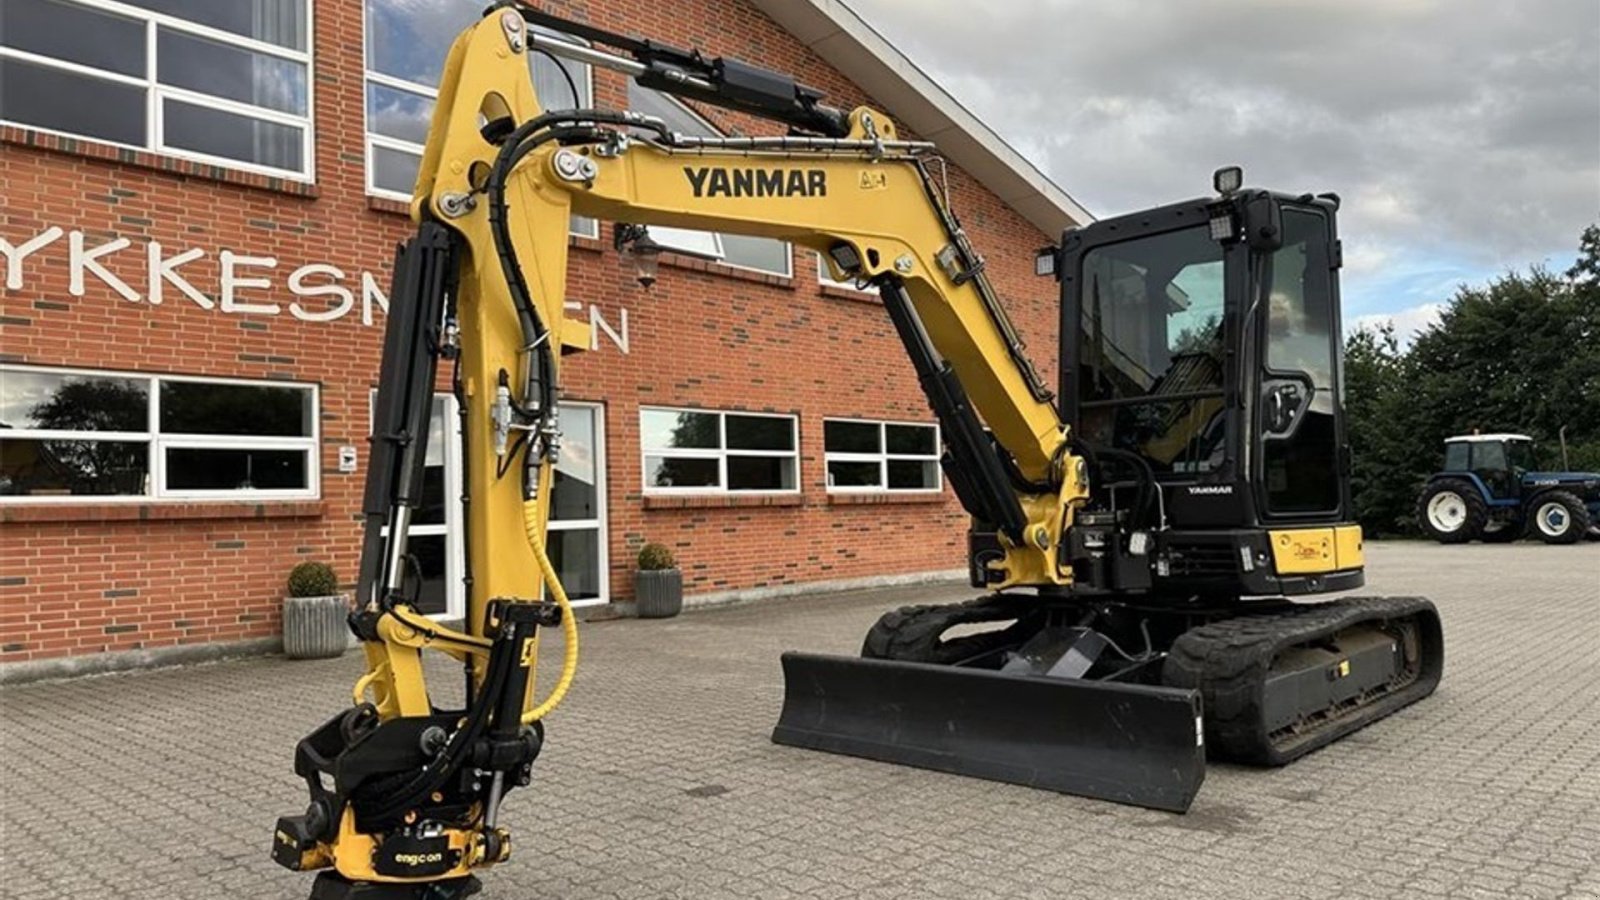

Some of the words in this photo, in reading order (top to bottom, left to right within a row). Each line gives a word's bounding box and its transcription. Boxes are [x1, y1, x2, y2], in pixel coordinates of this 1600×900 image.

[683, 166, 828, 198] YANMAR
[1188, 485, 1233, 495] YANMAR
[394, 852, 443, 867] engcon
